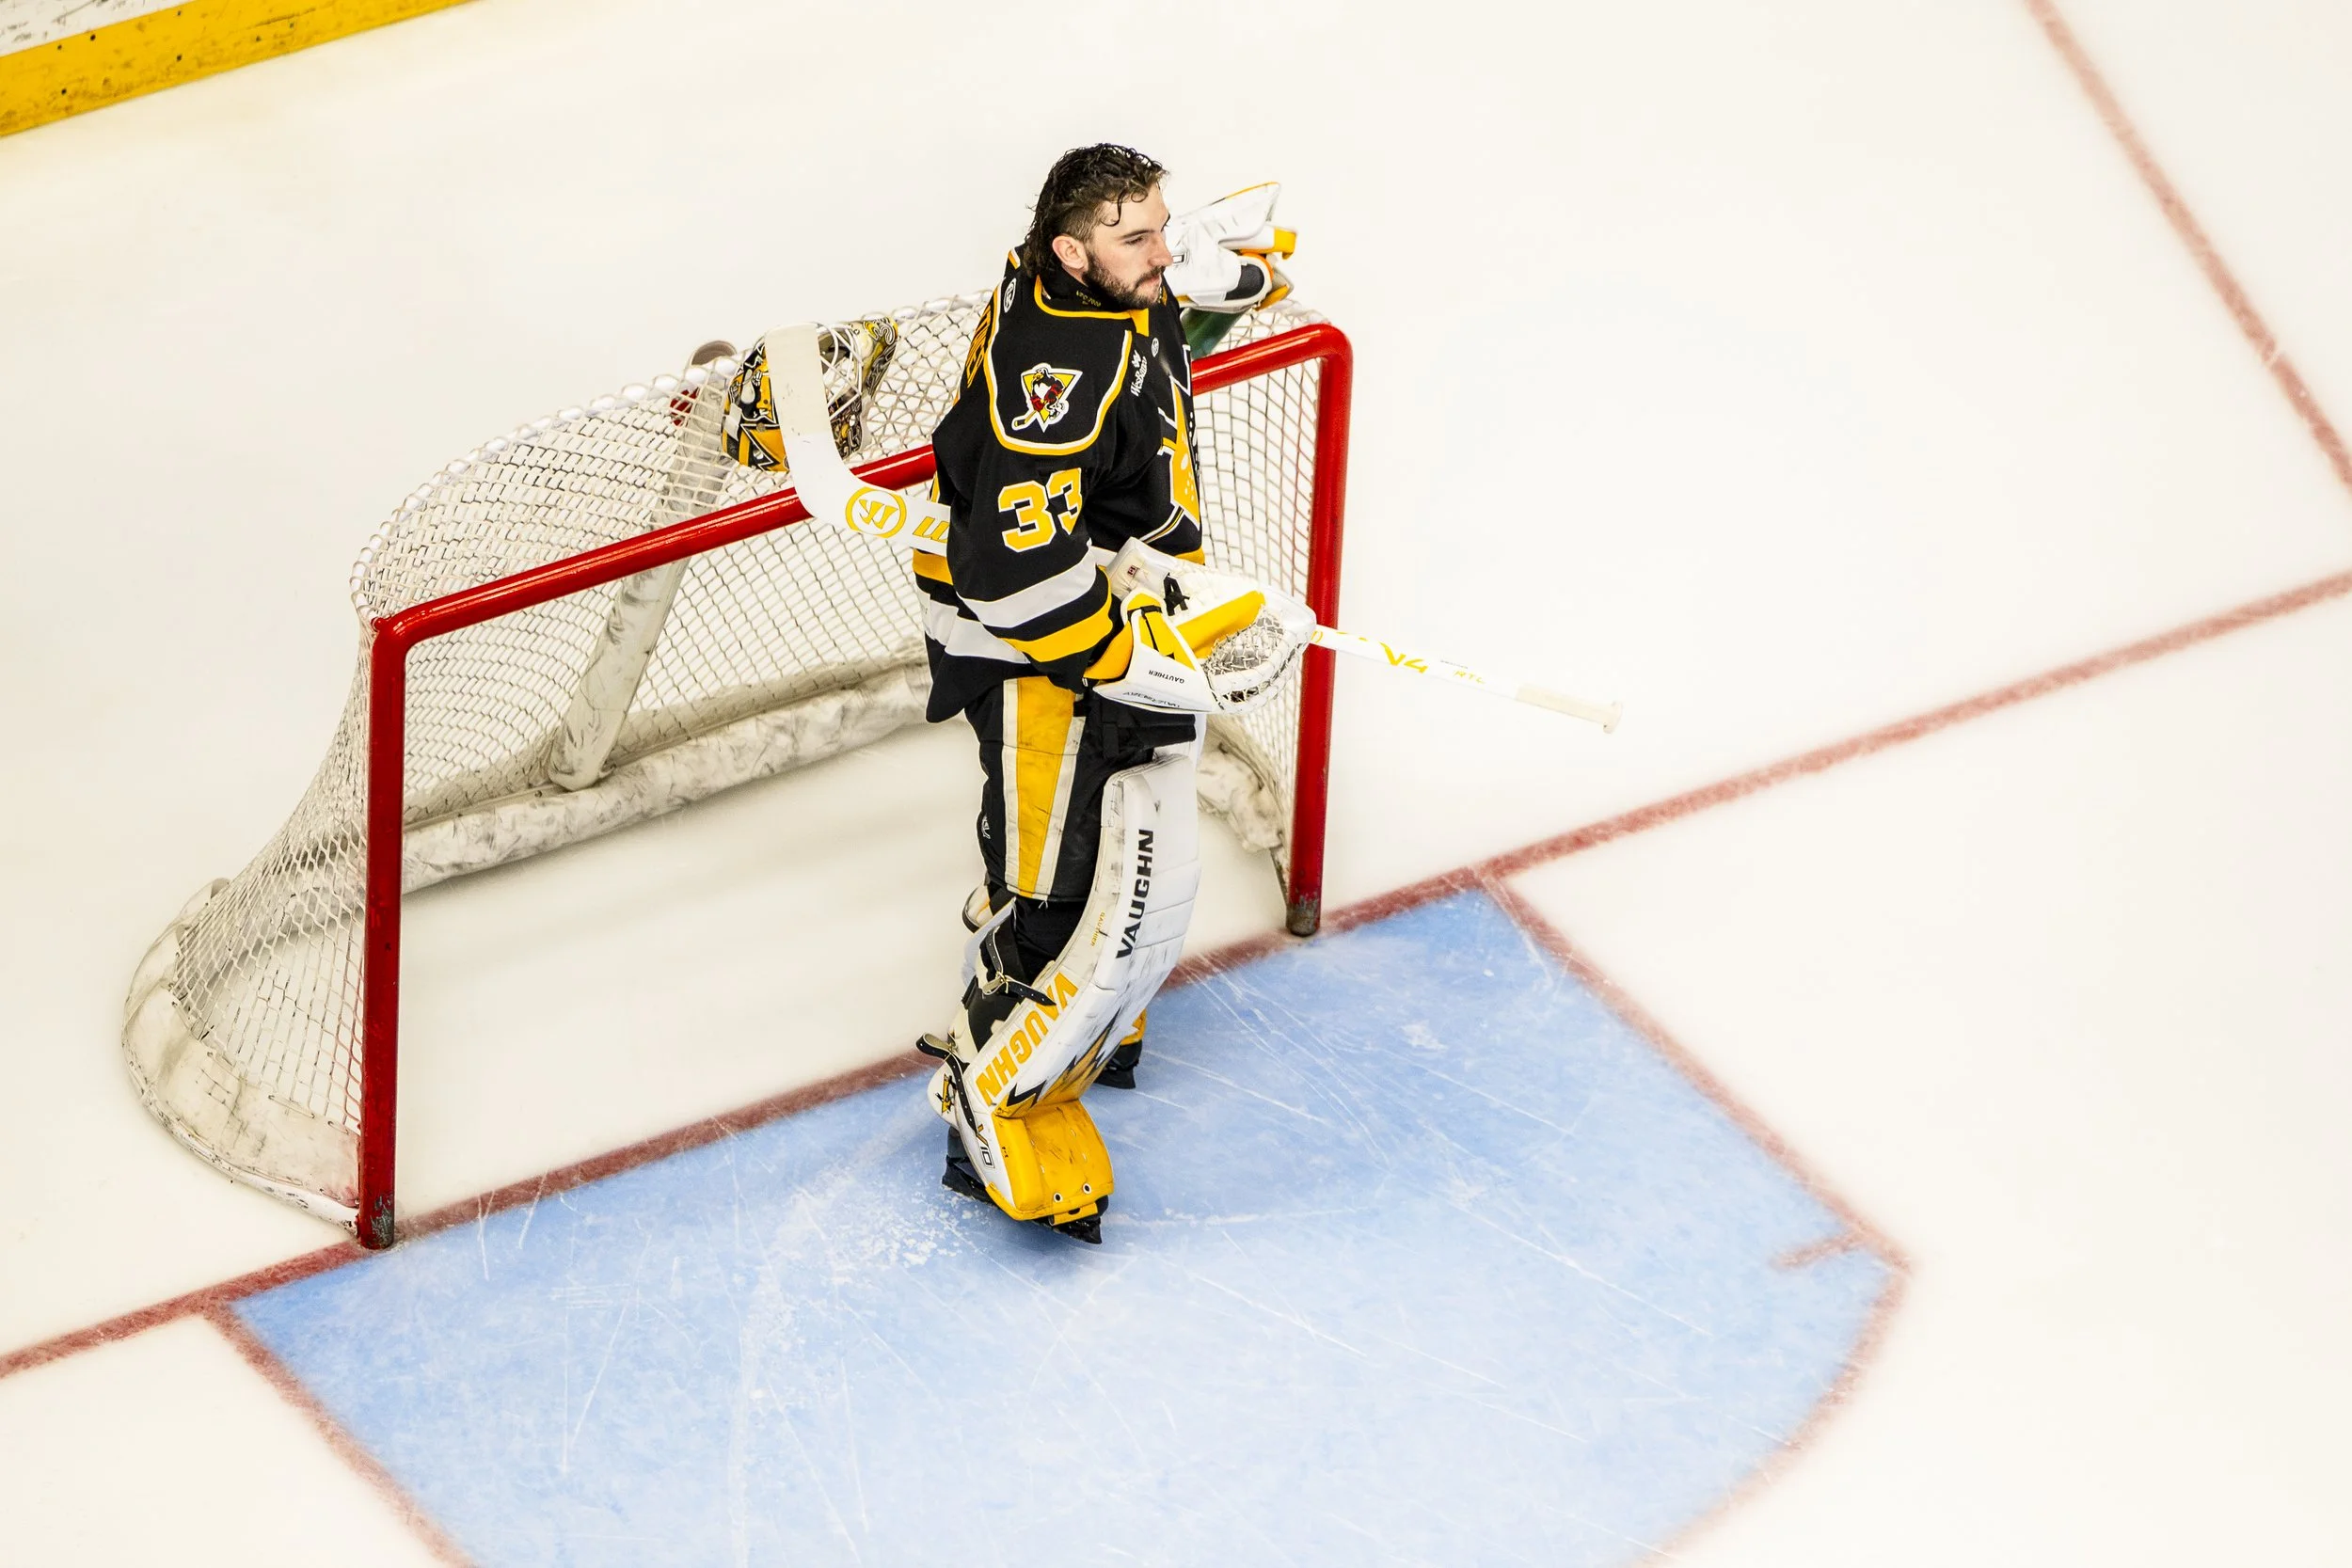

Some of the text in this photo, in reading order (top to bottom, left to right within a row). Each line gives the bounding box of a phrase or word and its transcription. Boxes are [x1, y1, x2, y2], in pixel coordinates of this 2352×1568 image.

[998, 467, 1083, 553] 33
[1148, 670, 1185, 684] GAUTHIER
[1117, 829, 1154, 958] VAUGHN
[976, 973, 1078, 1107] VAUGHN
